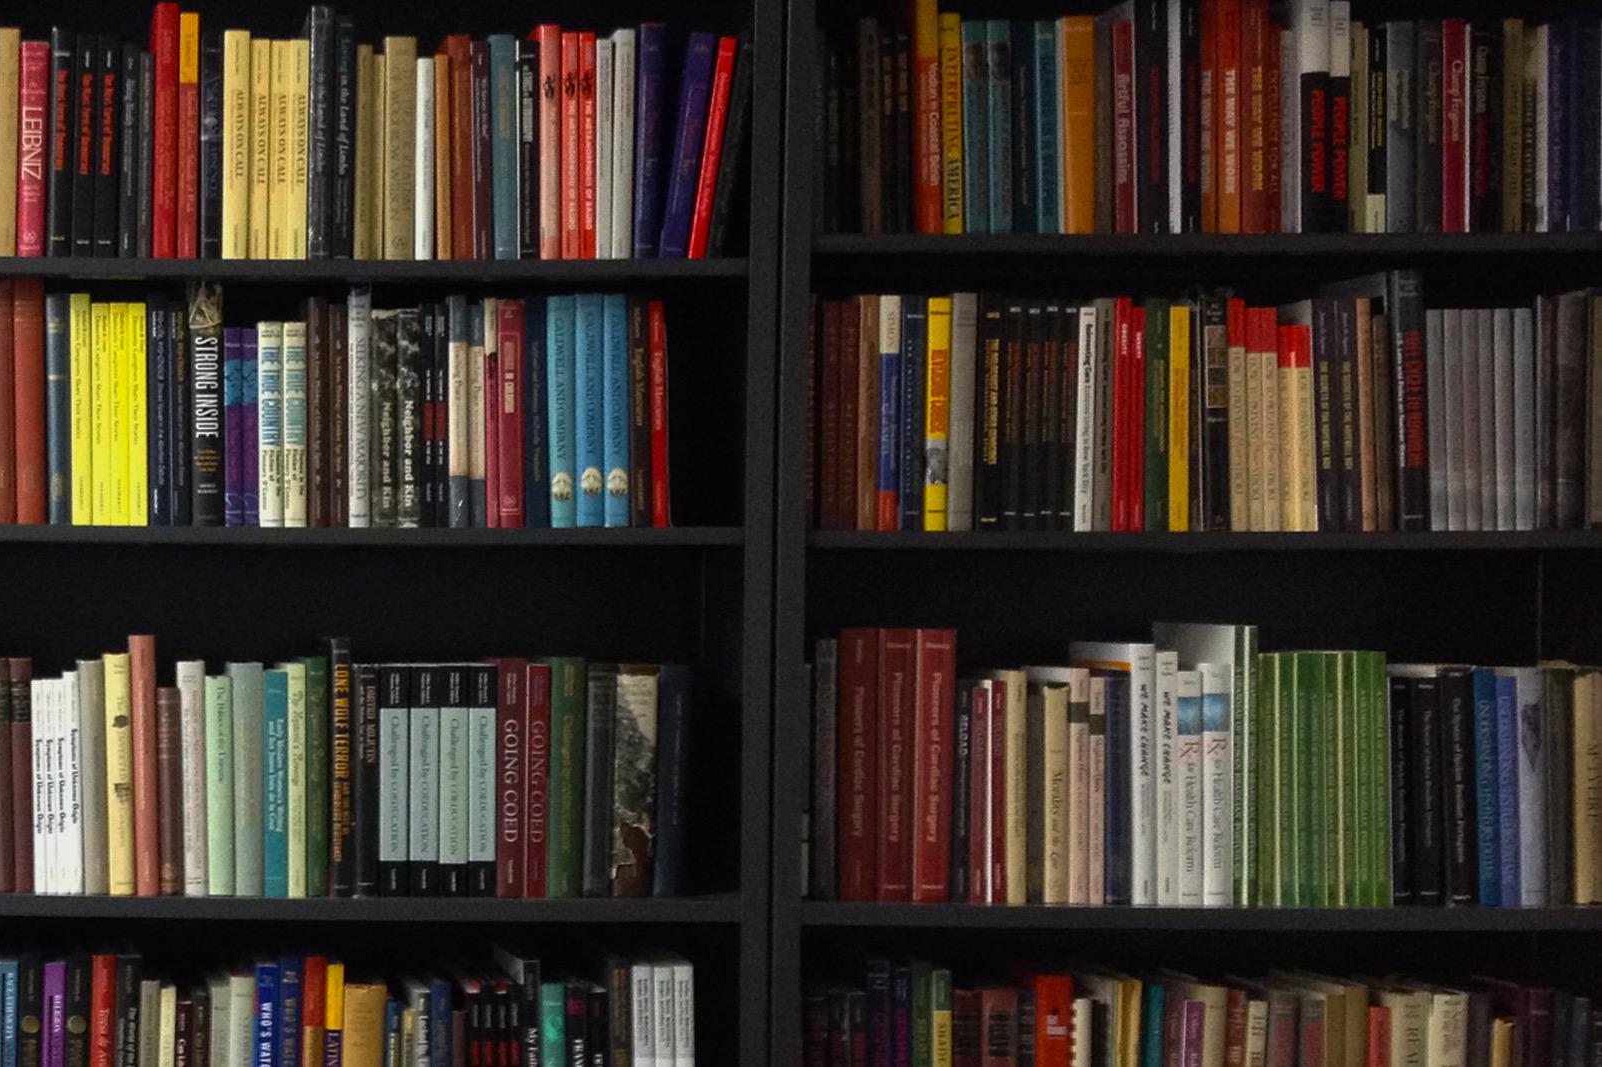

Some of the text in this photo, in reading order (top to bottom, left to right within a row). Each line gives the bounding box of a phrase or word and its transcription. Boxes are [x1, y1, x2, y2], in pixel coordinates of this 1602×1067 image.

[339, 106, 349, 129] Land
[340, 88, 349, 103] the
[1117, 74, 1131, 114] Artful
[22, 105, 42, 180] LEIBNIZ
[277, 94, 287, 184] ALWAYS ON CALL
[336, 131, 349, 143] of
[944, 47, 960, 220] INTERPRETING AMERICA
[1225, 69, 1235, 194] THE WAY WE WORK
[1311, 90, 1324, 192] PEOPLE POWER
[194, 337, 219, 438] STRONG INSIDE
[262, 346, 281, 447] THE TRUE COUNTRY
[555, 318, 568, 460] CALDWELL AND COMPANY
[1084, 368, 1093, 384] Care
[354, 337, 367, 501] SEEKING A NEW MAJORITY
[402, 400, 415, 507] Neighbor and Kin
[334, 664, 348, 778] LONE WOLF TERROR
[418, 715, 430, 766] Challenged
[931, 729, 942, 741] of
[1163, 692, 1172, 784] WE MAKE CHANGE
[418, 768, 430, 779] by
[504, 719, 518, 842] GOING COED
[929, 744, 941, 791] Cardiac
[1212, 772, 1225, 805] Health
[1213, 808, 1225, 829] Care
[1212, 832, 1224, 868] Reform
[53, 994, 62, 1033] RELIGION
[261, 1003, 272, 1037] WHO'S
